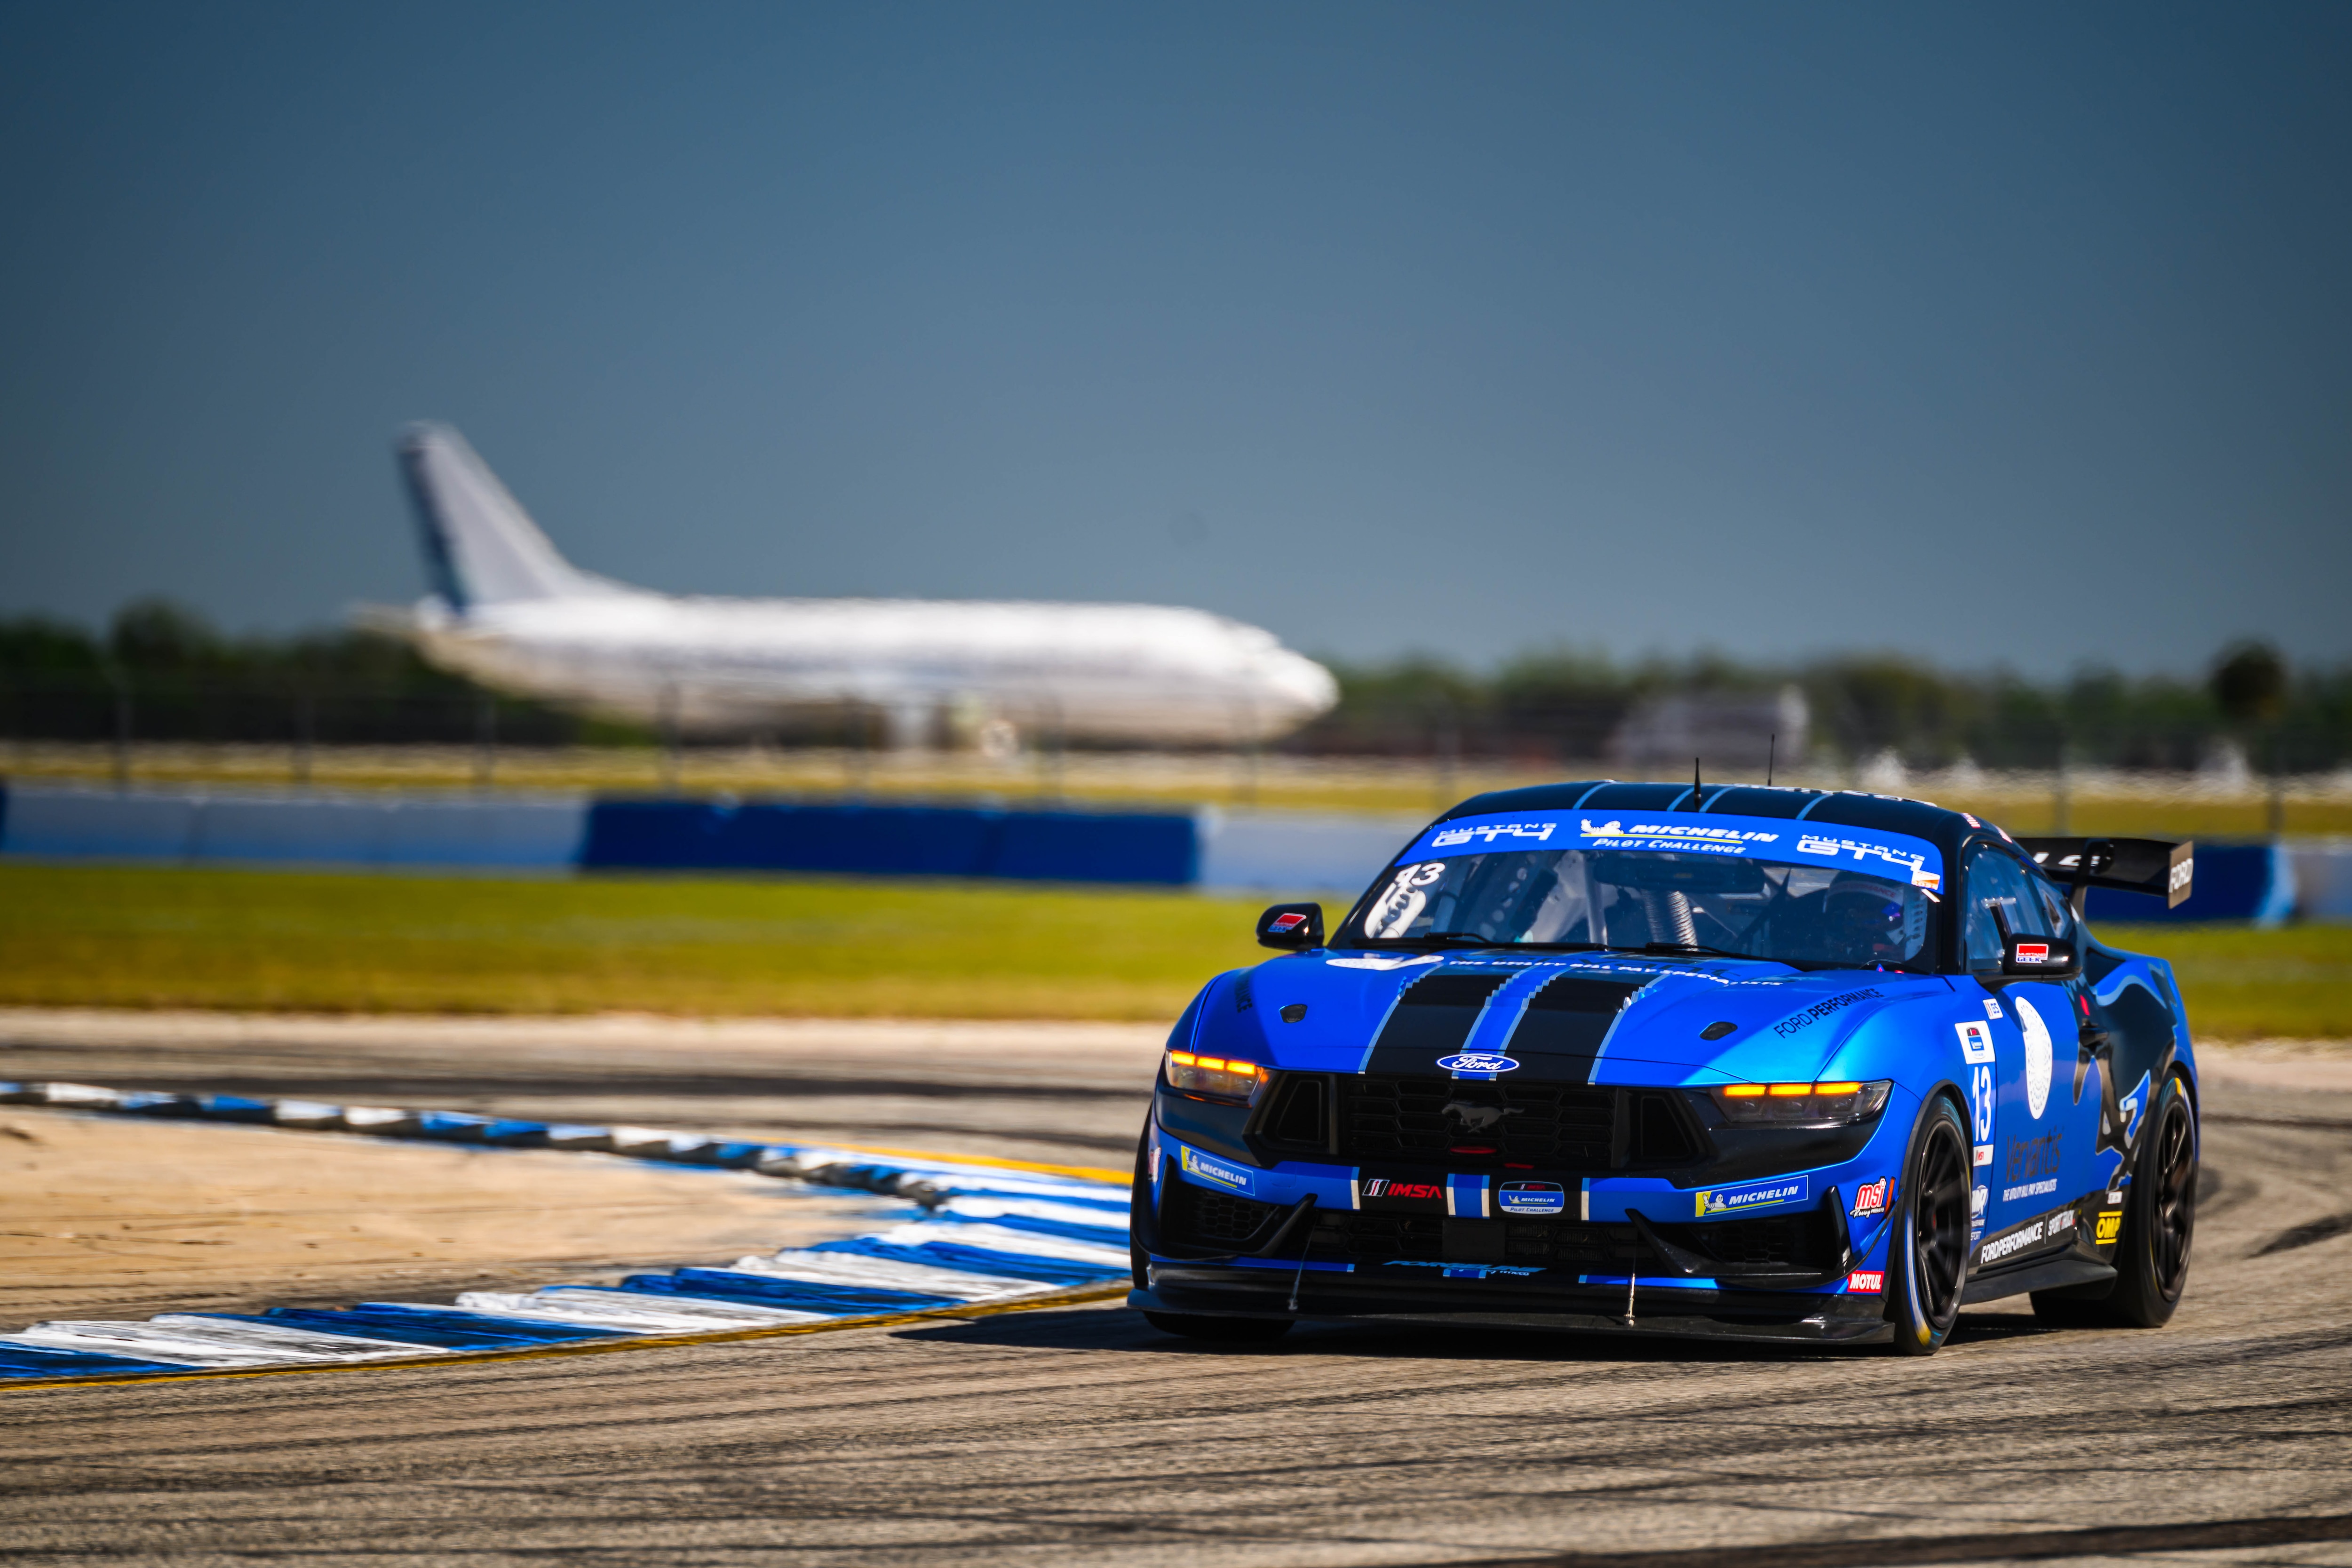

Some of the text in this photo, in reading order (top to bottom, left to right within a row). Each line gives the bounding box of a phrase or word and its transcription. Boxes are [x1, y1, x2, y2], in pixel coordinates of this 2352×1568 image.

[1431, 828, 1554, 847] GT4
[1629, 825, 1779, 842] MICHELIN
[1592, 838, 1747, 854] PILOT CHALLENGE
[1796, 839, 1923, 871] GT4
[1802, 835, 1925, 861] MUSTANG
[2169, 858, 2193, 893] FORD
[1773, 988, 1885, 1039] FORD PERFORMANCE
[1452, 1056, 1504, 1070] Ford
[1972, 1066, 1991, 1142] 13
[2006, 1125, 2063, 1183] Vervantis
[1200, 1162, 1247, 1186] MICHELIN
[1388, 1183, 1443, 1199] IMSA
[1729, 1186, 1799, 1205] MICHELIN
[2096, 1217, 2121, 1238] OMP
[1849, 1274, 1882, 1289] MOTUL
